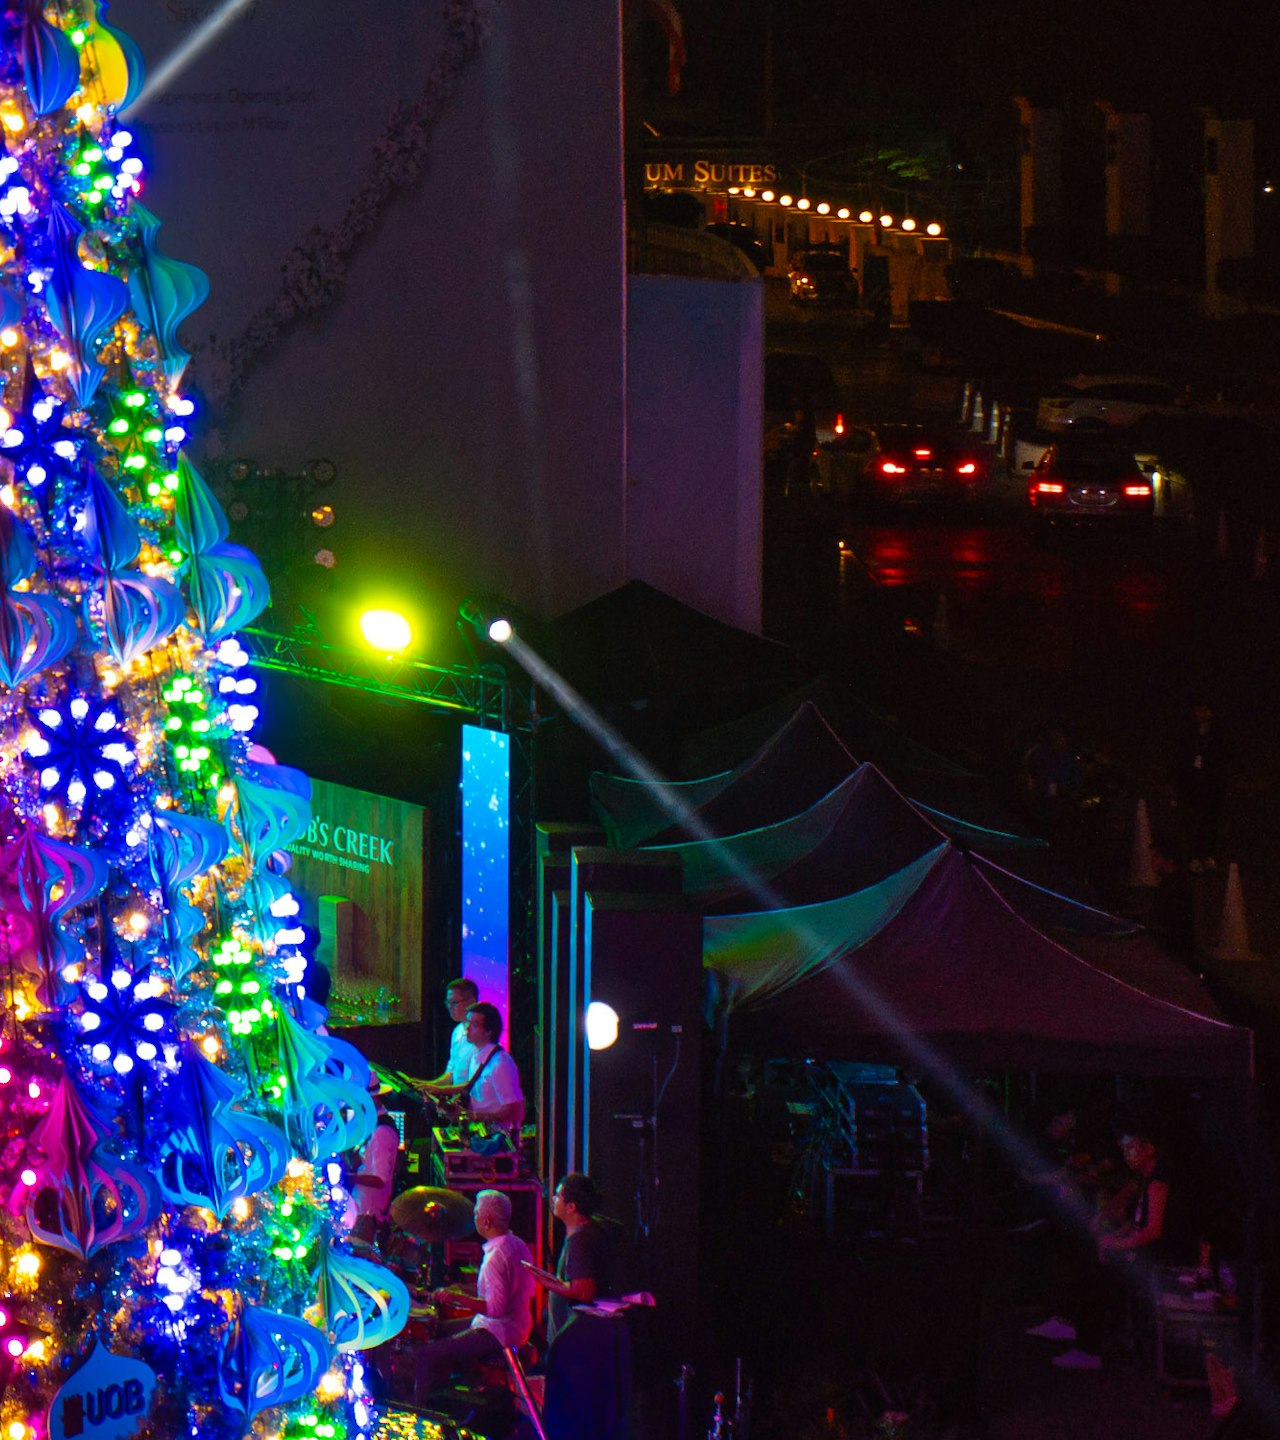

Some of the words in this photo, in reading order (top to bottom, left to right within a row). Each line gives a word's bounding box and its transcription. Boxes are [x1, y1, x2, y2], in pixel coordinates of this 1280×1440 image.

[285, 843, 311, 857] UALITY
[311, 848, 339, 864] WORTH
[339, 857, 370, 874] SHARING
[333, 826, 394, 866] CREEK
[86, 1378, 146, 1426] UOB
